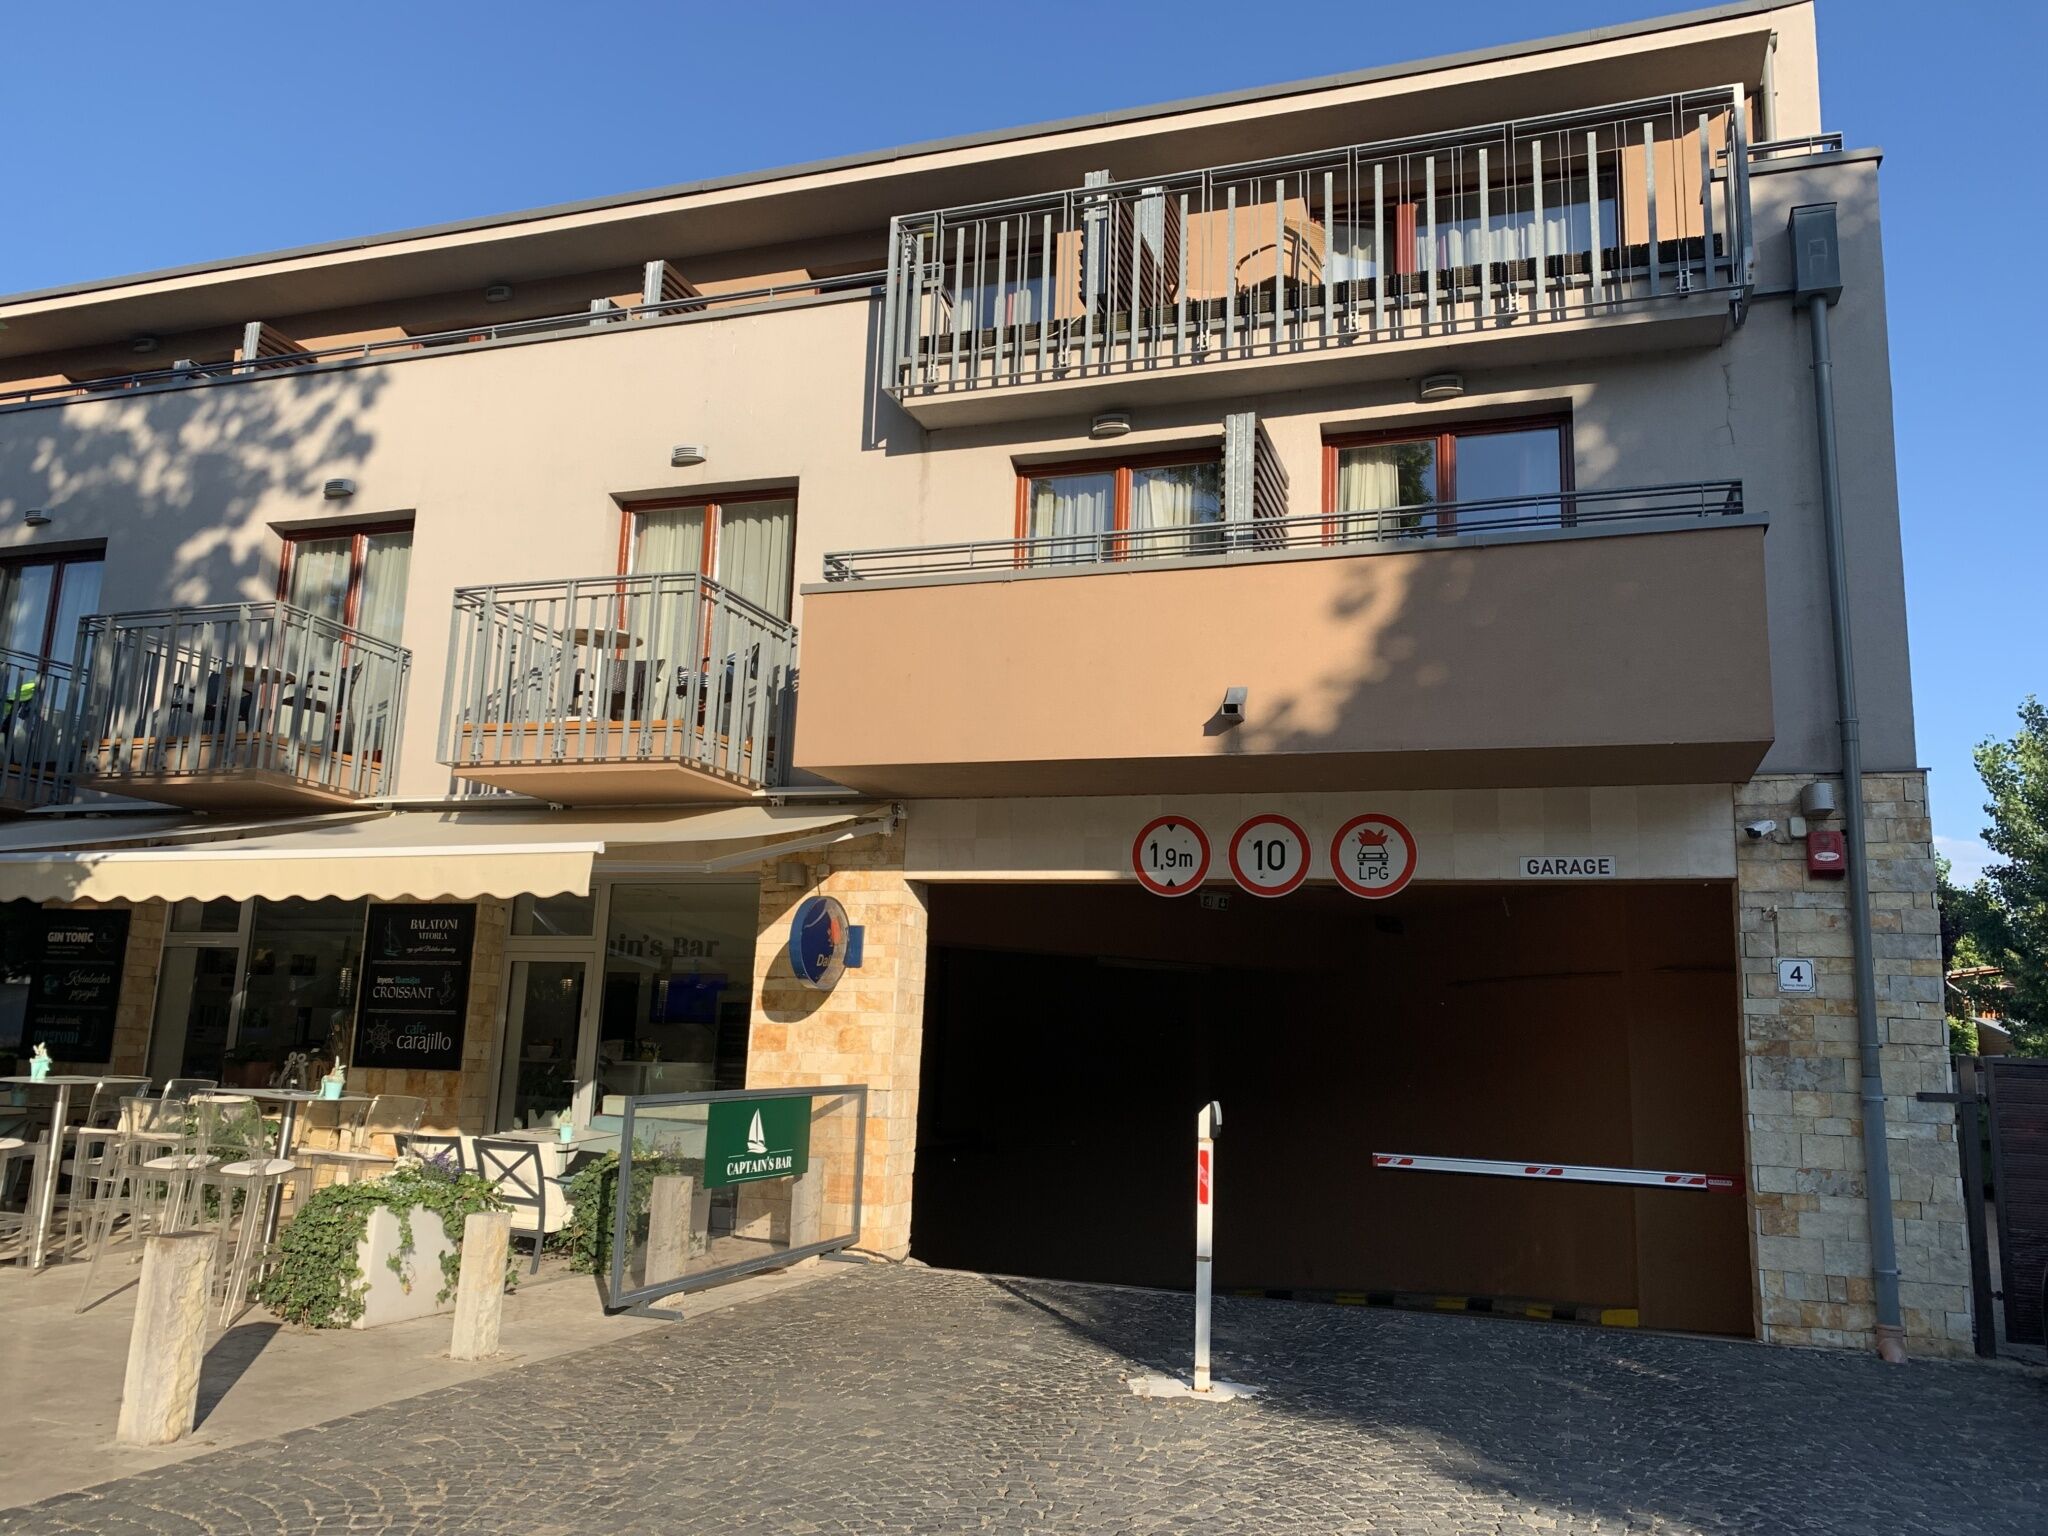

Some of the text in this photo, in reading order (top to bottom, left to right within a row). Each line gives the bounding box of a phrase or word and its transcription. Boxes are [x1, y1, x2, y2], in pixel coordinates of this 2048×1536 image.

[1253, 840, 1286, 871] 10
[1358, 866, 1389, 881] LPG
[1527, 859, 1610, 875] GARAGE
[410, 919, 458, 930] BALATONI
[47, 931, 95, 943] GIN TONIC
[417, 932, 448, 940] VITORLA
[672, 936, 721, 957] Bar
[1789, 965, 1804, 983] 4
[372, 986, 434, 999] CROISSANT
[396, 1031, 452, 1053] carajillo
[726, 1156, 792, 1176] CAPTAIN'S BAR
